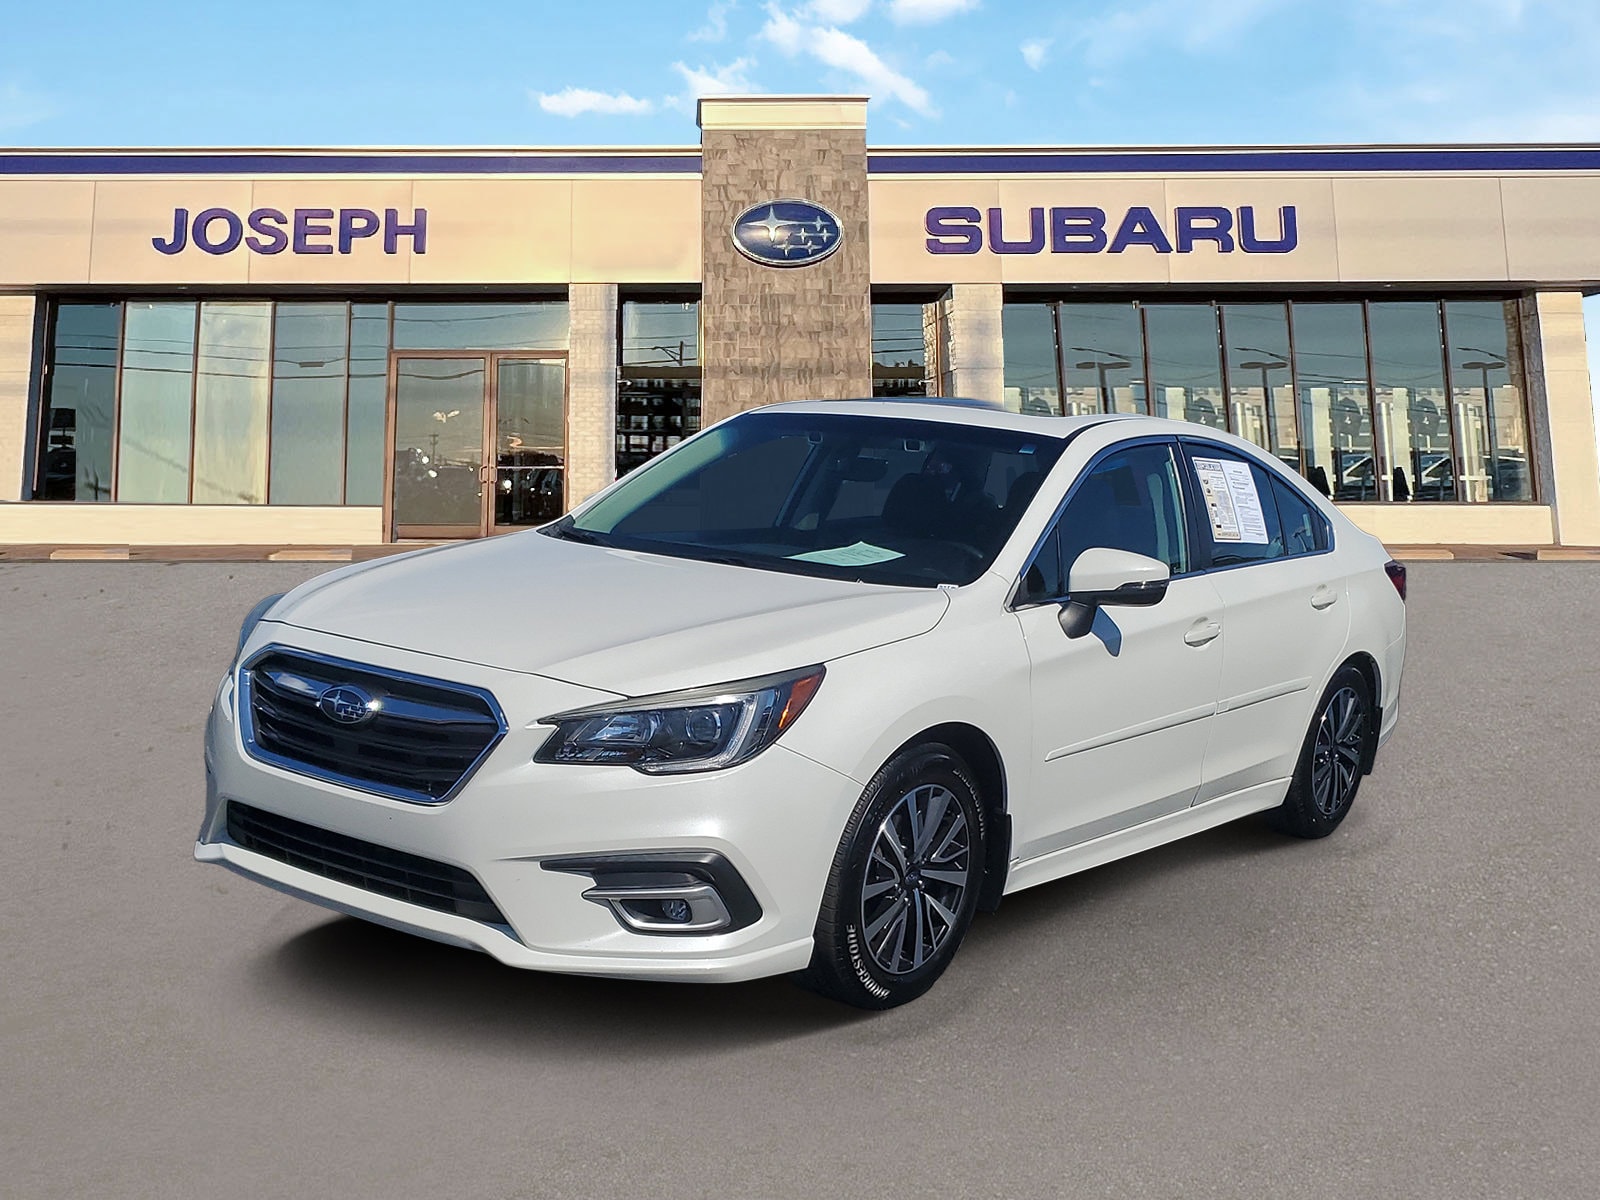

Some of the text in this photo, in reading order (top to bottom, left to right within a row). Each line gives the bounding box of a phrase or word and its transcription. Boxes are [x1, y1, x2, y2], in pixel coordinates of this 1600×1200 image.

[152, 208, 427, 255] JOSEPH
[926, 206, 1297, 254] SUBARU
[846, 924, 891, 1000] BRIDGESTONE
